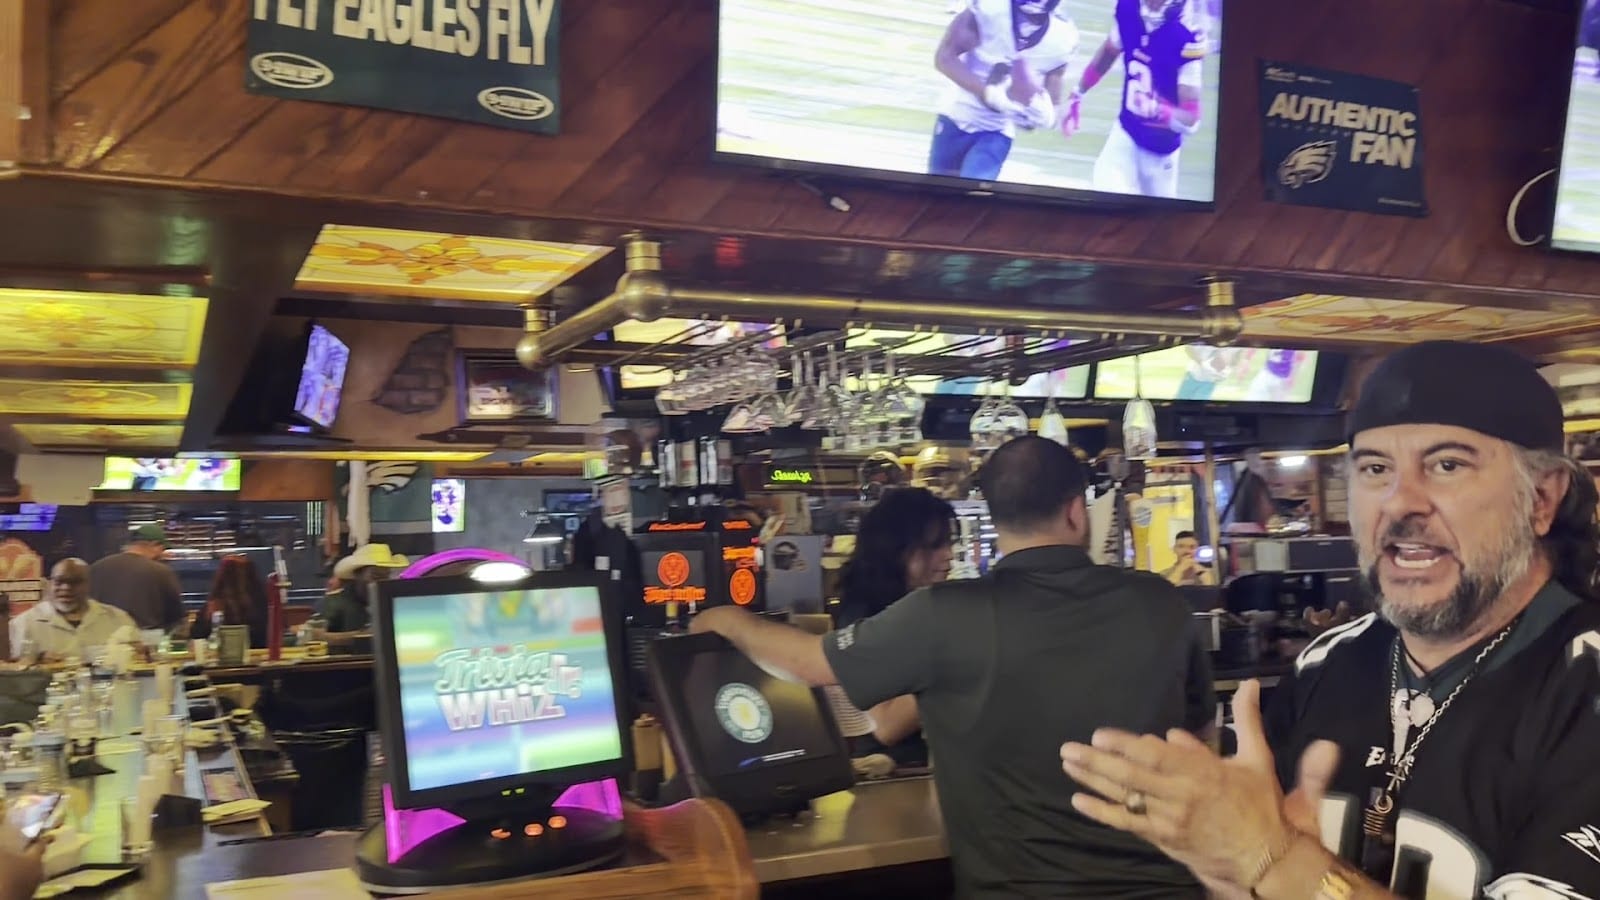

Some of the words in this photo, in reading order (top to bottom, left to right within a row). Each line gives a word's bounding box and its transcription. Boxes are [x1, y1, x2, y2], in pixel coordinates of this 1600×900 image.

[333, 0, 480, 57] EAGLES
[487, 0, 554, 66] FLY
[1266, 92, 1416, 136] AUTHENTIC
[1350, 131, 1416, 169] FAN
[434, 645, 552, 693] Trivia
